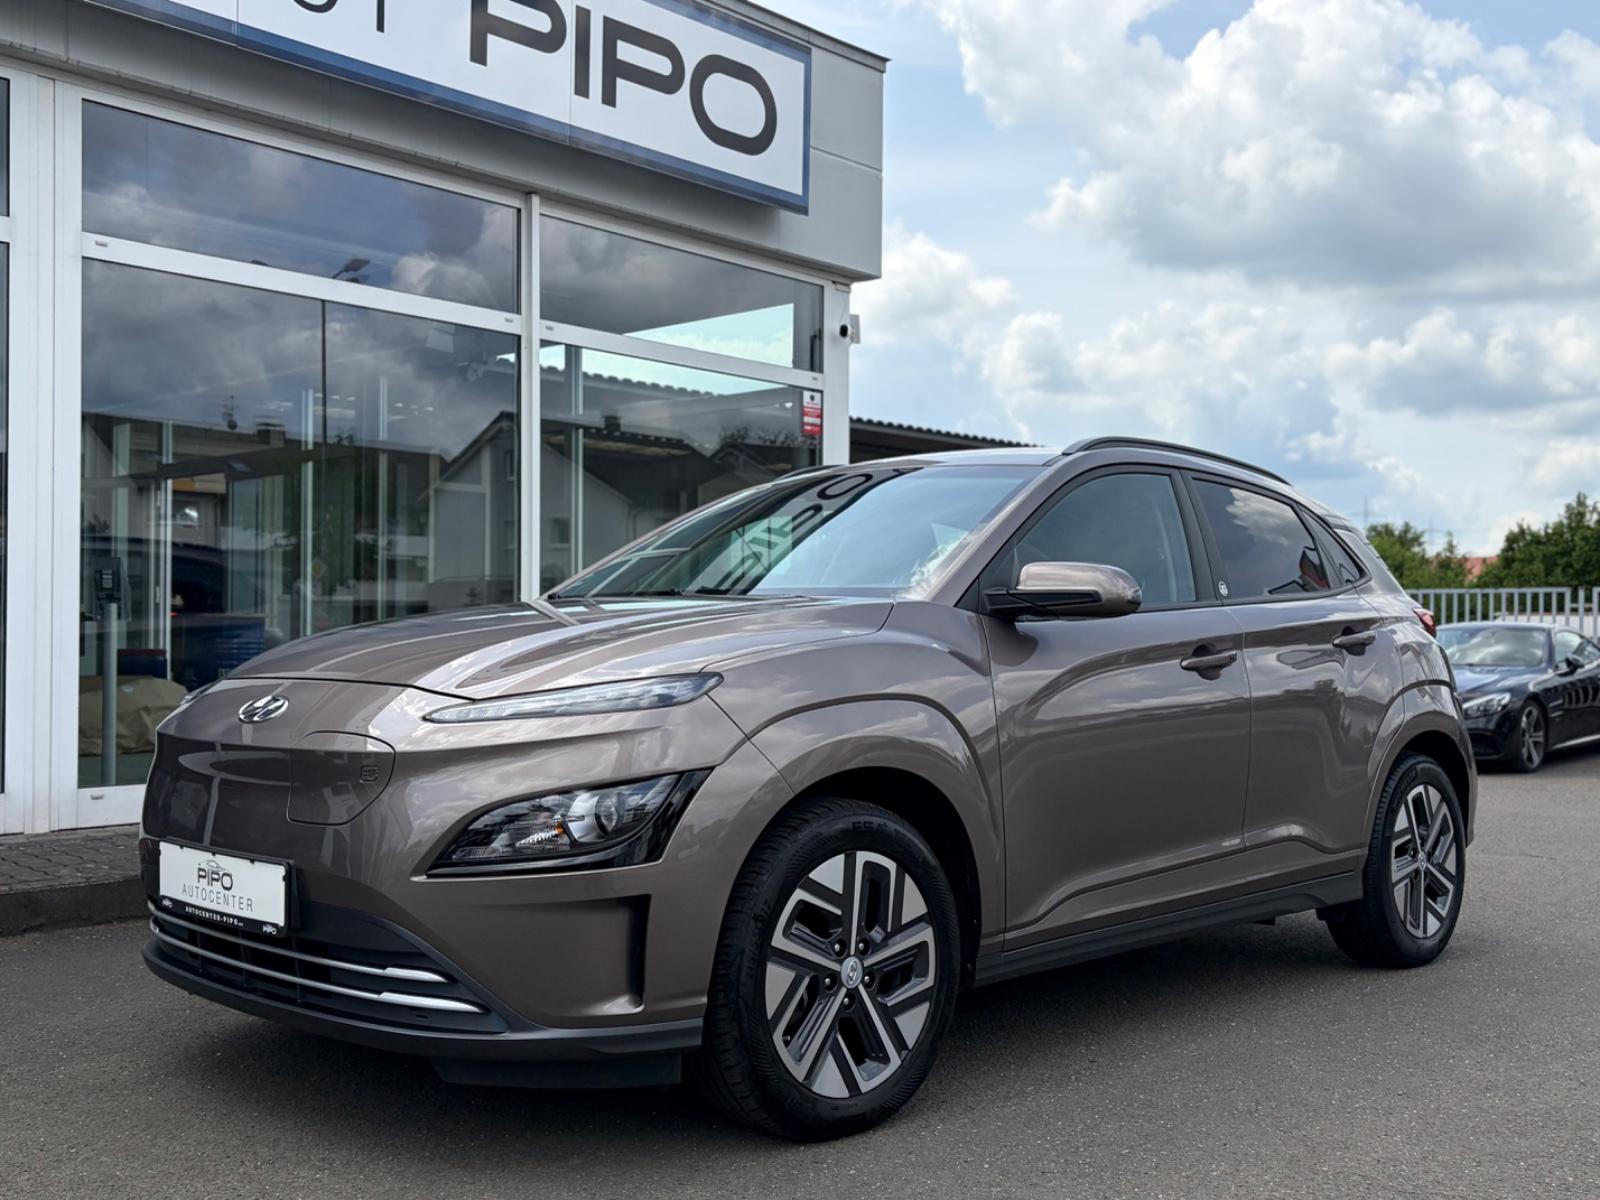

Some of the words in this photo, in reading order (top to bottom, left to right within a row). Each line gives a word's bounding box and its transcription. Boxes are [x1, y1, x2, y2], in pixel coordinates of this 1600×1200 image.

[470, 0, 777, 156] PIPO
[197, 867, 234, 892] PIPO
[182, 883, 254, 912] AUTOCENTER
